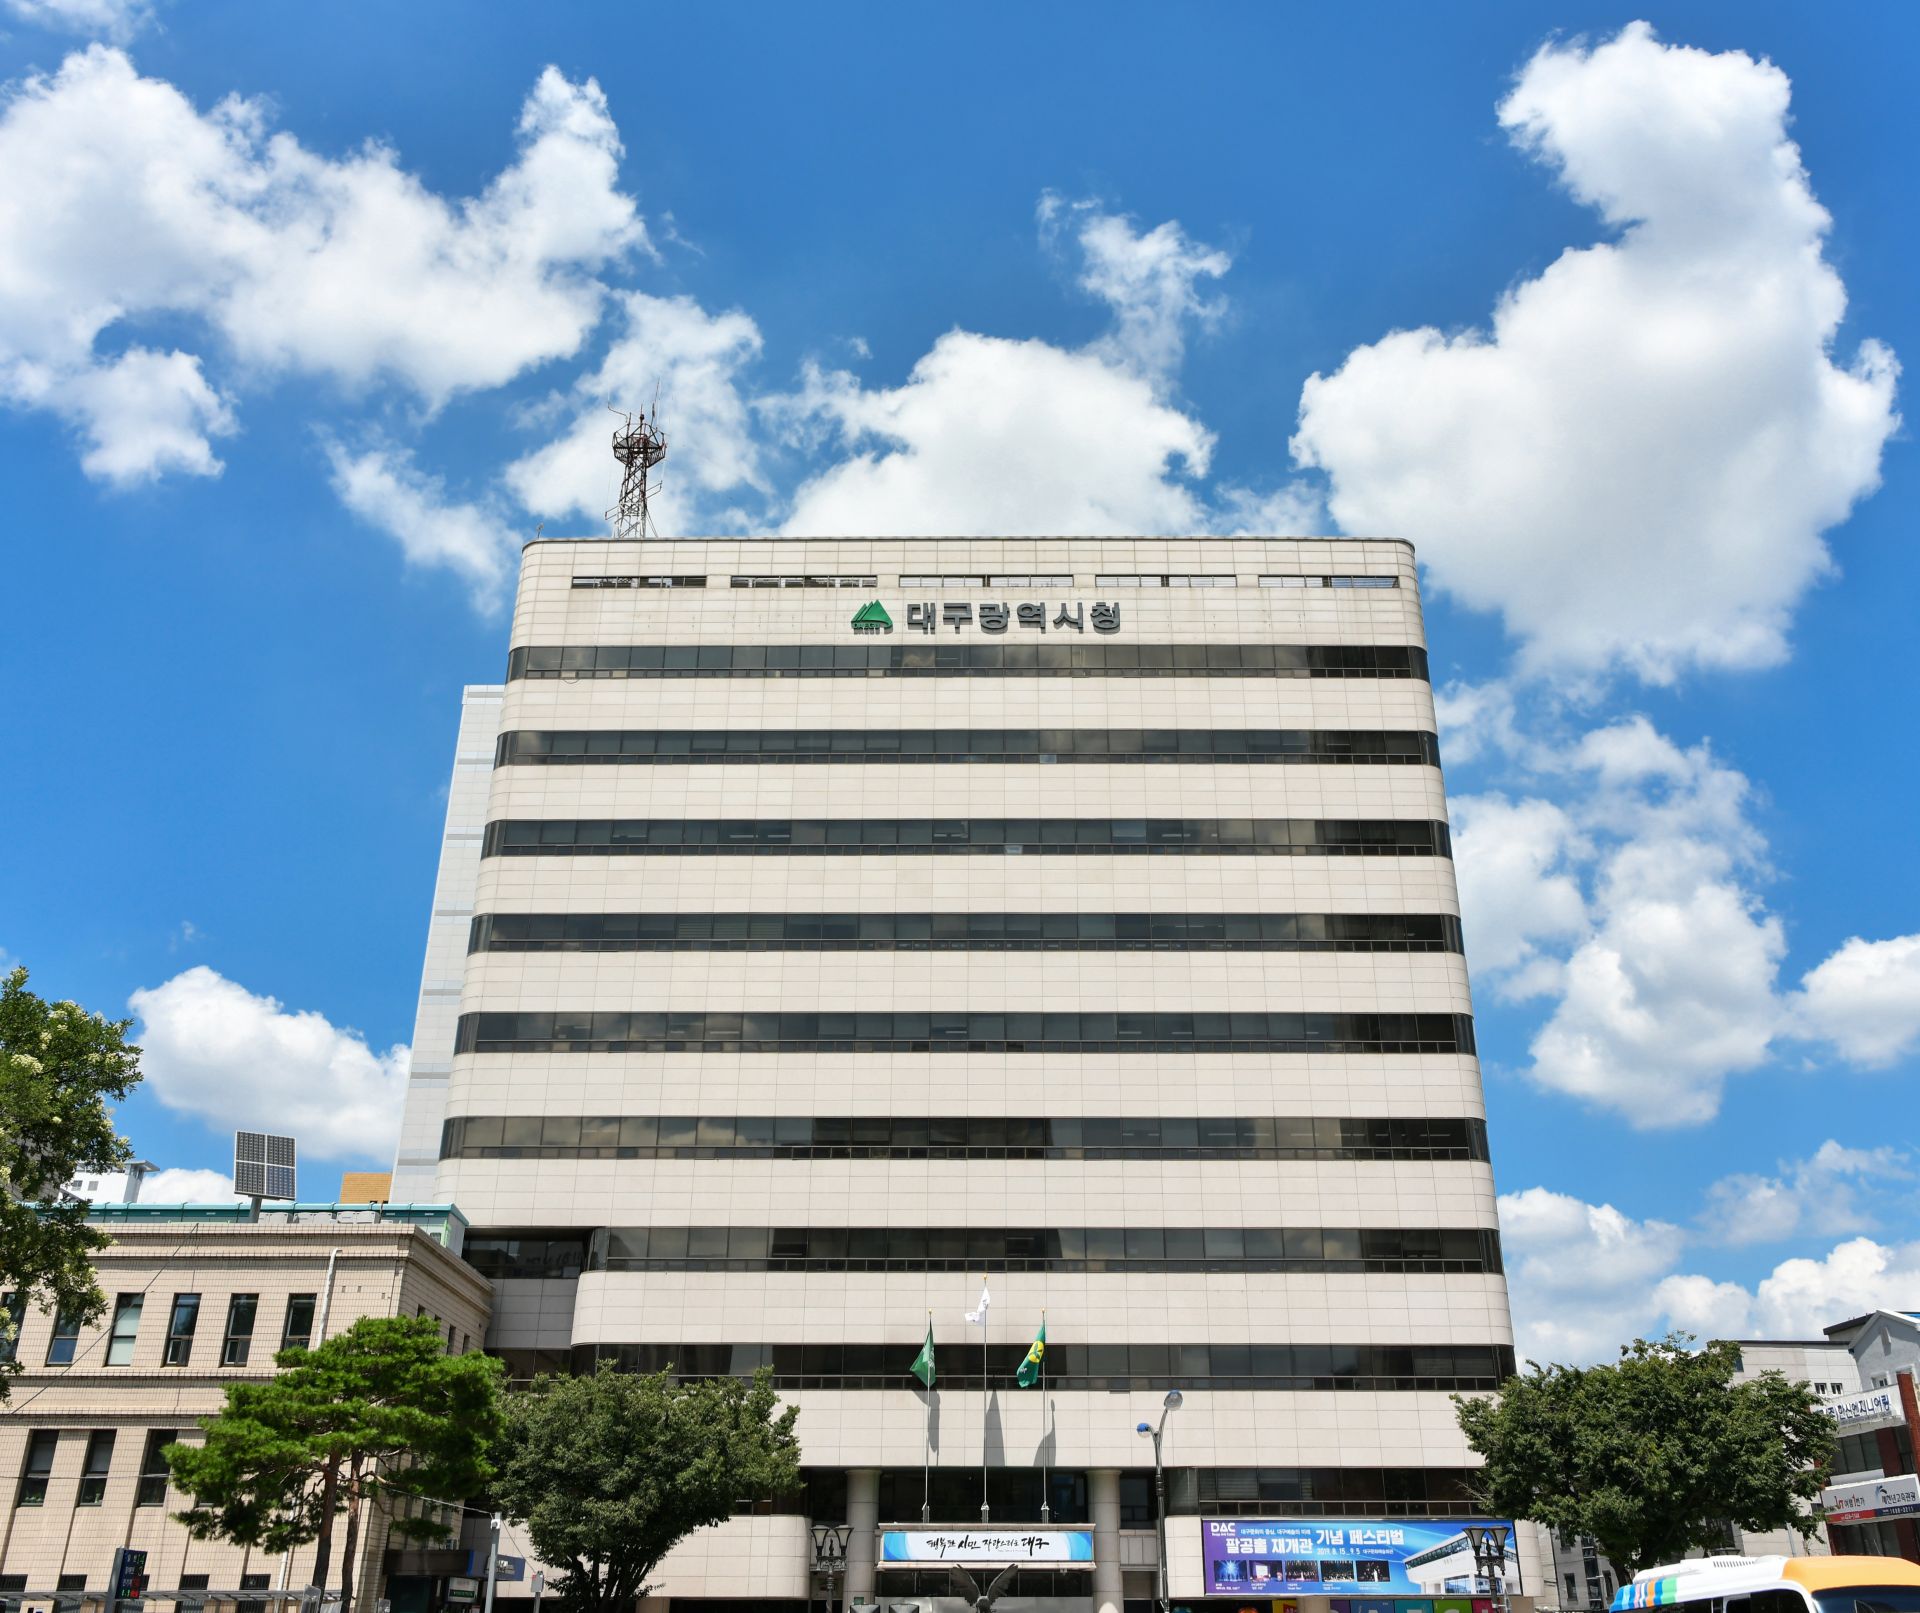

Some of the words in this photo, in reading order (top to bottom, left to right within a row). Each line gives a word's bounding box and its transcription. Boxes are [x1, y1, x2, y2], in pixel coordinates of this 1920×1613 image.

[907, 602, 1121, 631] 대구광역시청
[1211, 1522, 1236, 1532] DAC
[957, 1534, 981, 1550] 시민
[1021, 1536, 1050, 1557] 대구
[1226, 1537, 1267, 1554] 팔공홀
[1272, 1537, 1313, 1554] 재개관
[1316, 1529, 1344, 1545] 기념
[1349, 1529, 1405, 1545] 페스티벌
